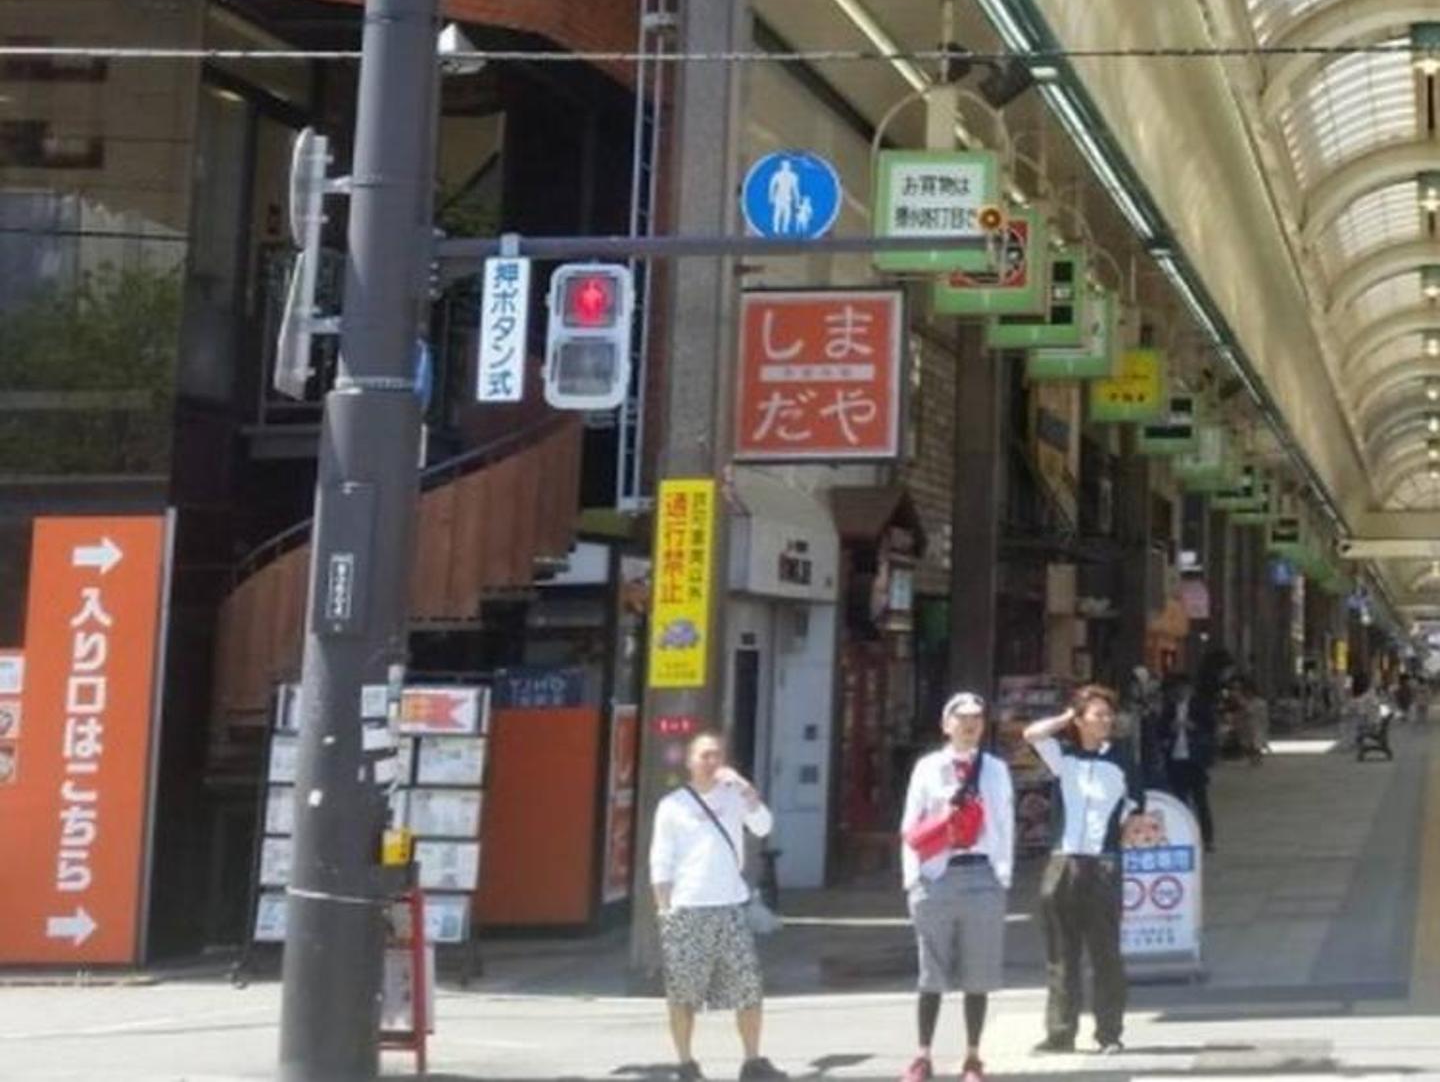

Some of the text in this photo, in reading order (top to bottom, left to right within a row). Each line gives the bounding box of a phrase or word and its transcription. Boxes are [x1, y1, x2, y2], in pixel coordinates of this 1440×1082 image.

[903, 175, 969, 196] お買物は
[487, 262, 519, 397] 押ボタン式
[659, 492, 689, 605] 通行禁止
[56, 587, 113, 892] 入り口はこちら
